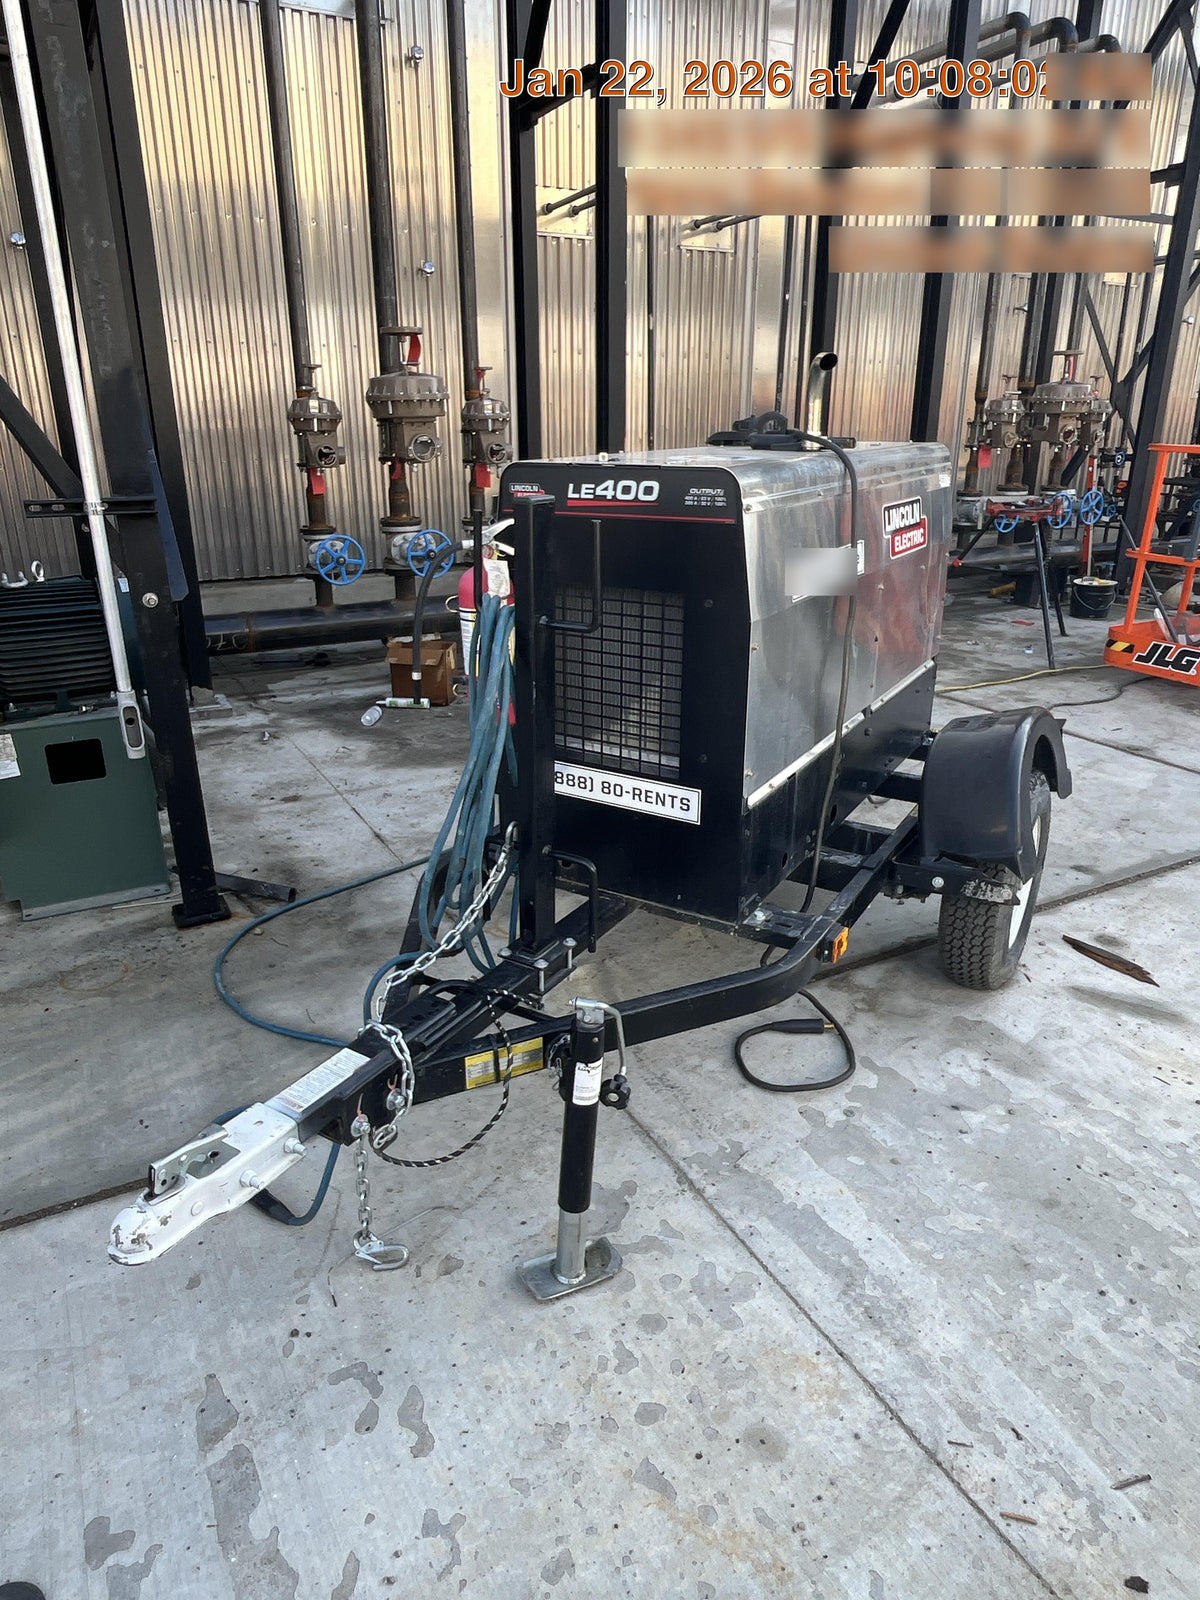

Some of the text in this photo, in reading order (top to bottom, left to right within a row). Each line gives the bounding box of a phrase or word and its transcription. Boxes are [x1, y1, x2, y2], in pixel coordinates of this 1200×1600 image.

[567, 480, 661, 502] LE400
[885, 502, 920, 532] LINCOLN
[894, 528, 925, 552] ELECTRIC
[1133, 641, 1200, 674] JLG
[601, 781, 691, 812] 80-RENTS
